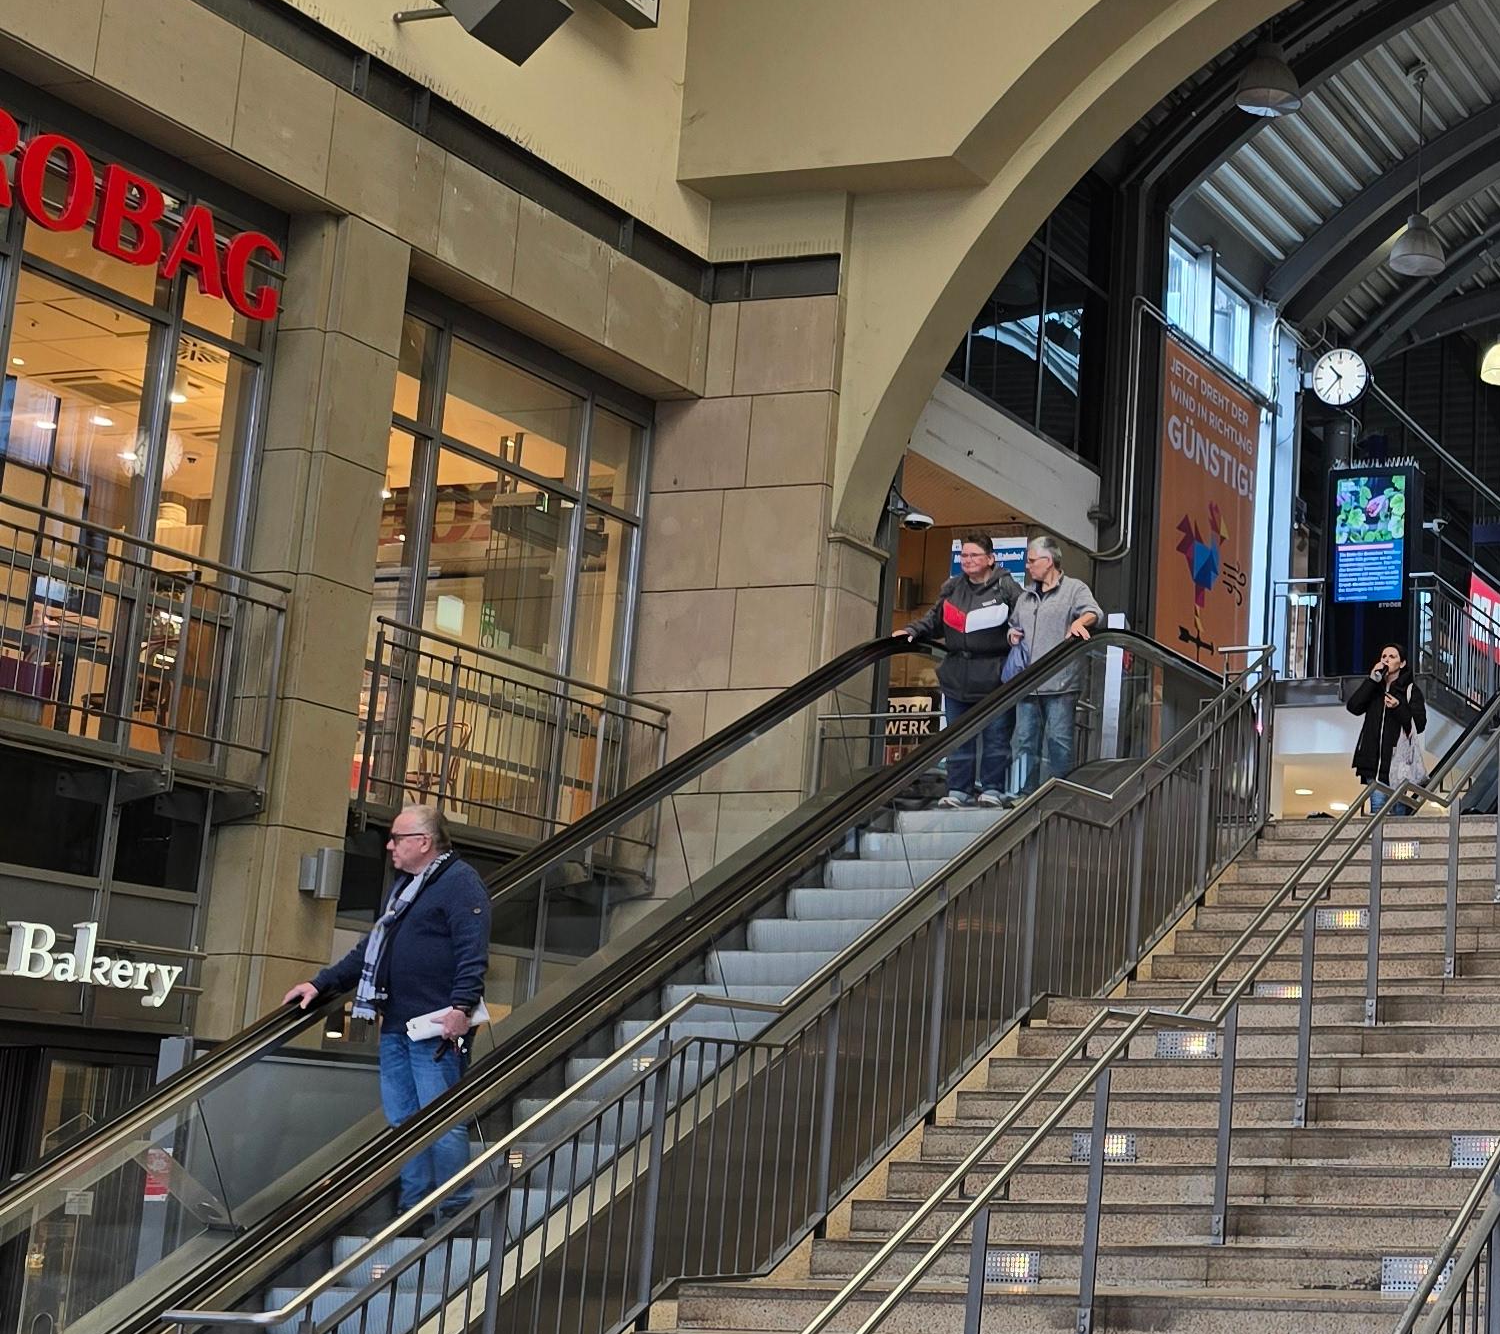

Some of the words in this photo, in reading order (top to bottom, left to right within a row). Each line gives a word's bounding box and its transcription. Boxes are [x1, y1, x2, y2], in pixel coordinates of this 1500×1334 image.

[0, 107, 283, 321] OBAG
[1169, 356, 1199, 390] JETZT
[1200, 379, 1229, 414] DREHT
[1230, 403, 1249, 428] DER
[1170, 379, 1196, 414] WIND
[1197, 405, 1208, 426] IN
[1208, 413, 1253, 456] RICHTUNG
[1167, 414, 1254, 502] GÜNSTIG!
[885, 719, 931, 736] WERK
[6, 920, 183, 1008] Bakery
